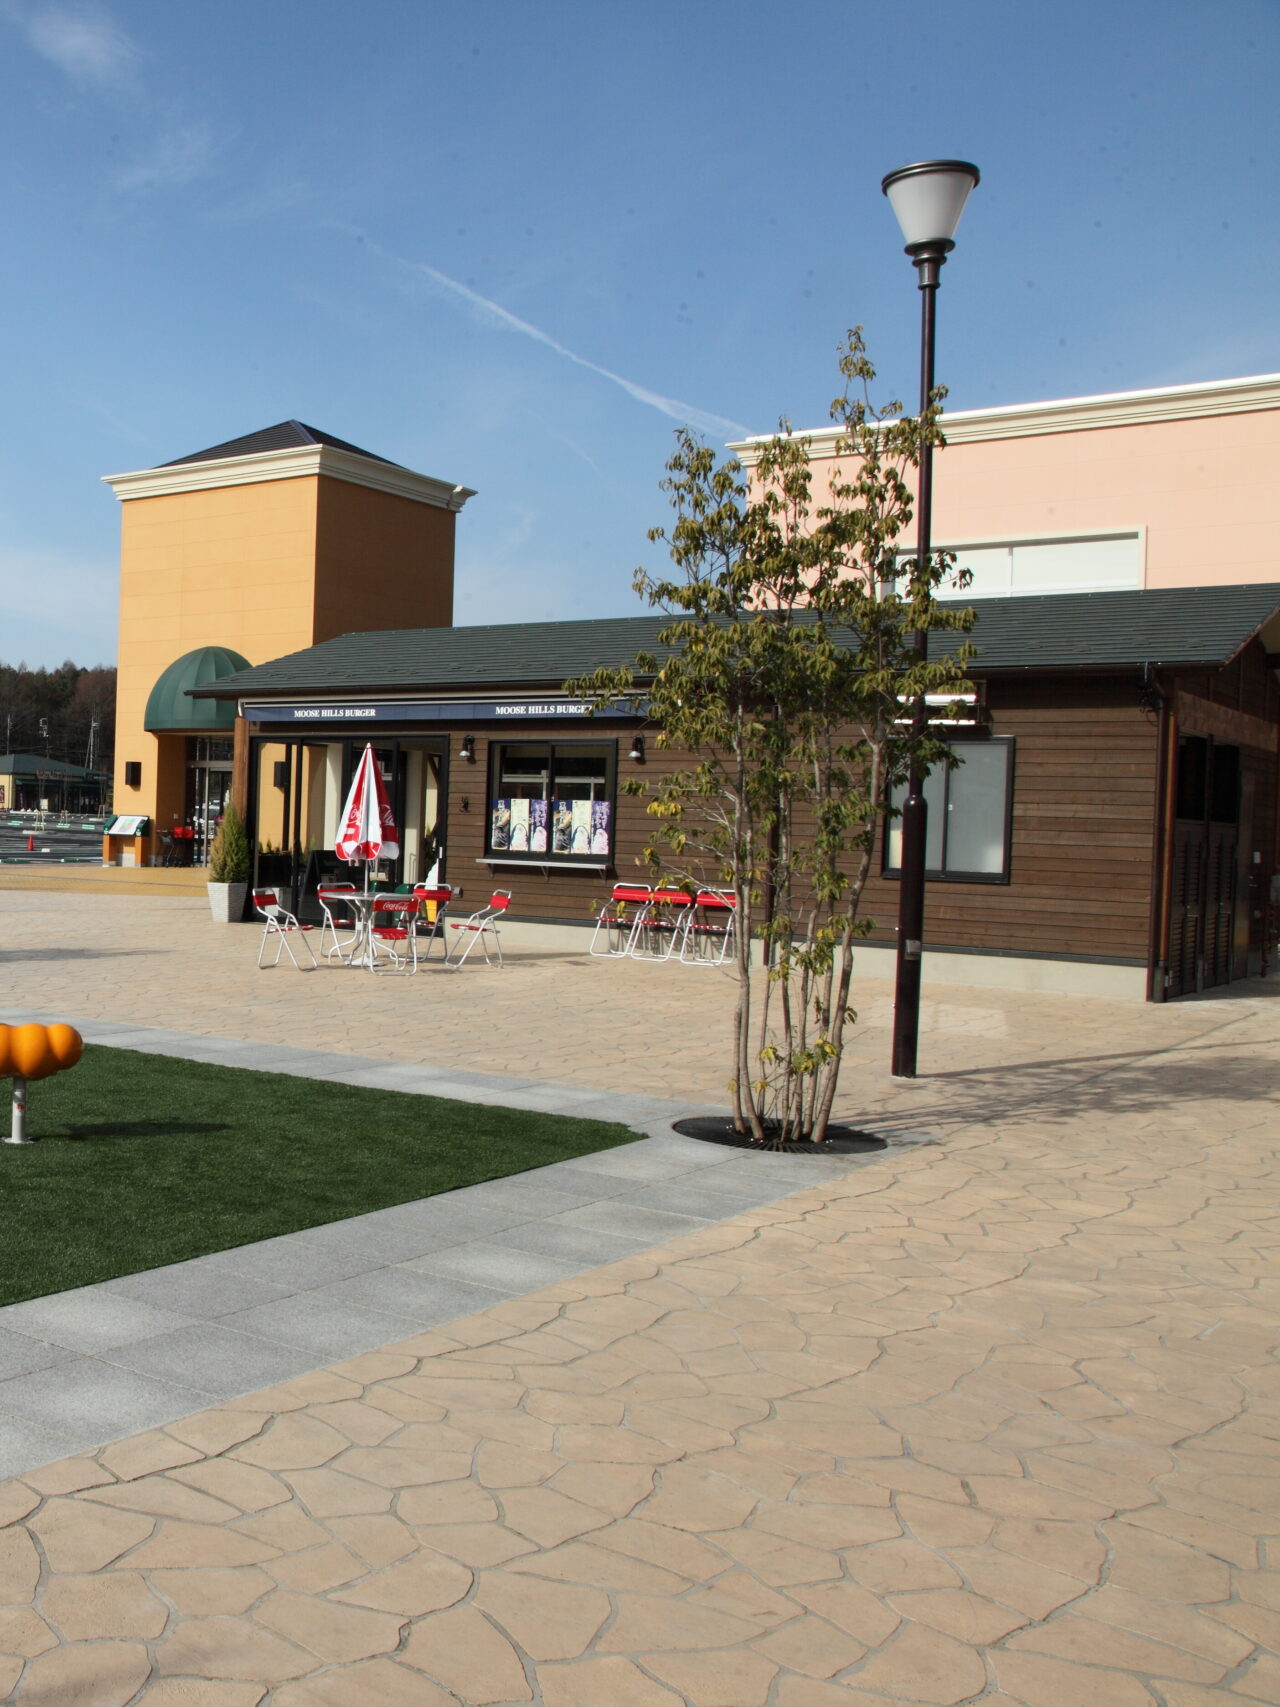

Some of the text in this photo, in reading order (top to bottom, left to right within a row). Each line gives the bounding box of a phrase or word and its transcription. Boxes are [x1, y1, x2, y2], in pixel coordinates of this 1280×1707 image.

[321, 709, 344, 717] HILLS
[495, 706, 526, 714] MOOSE
[528, 705, 555, 714] HILLS
